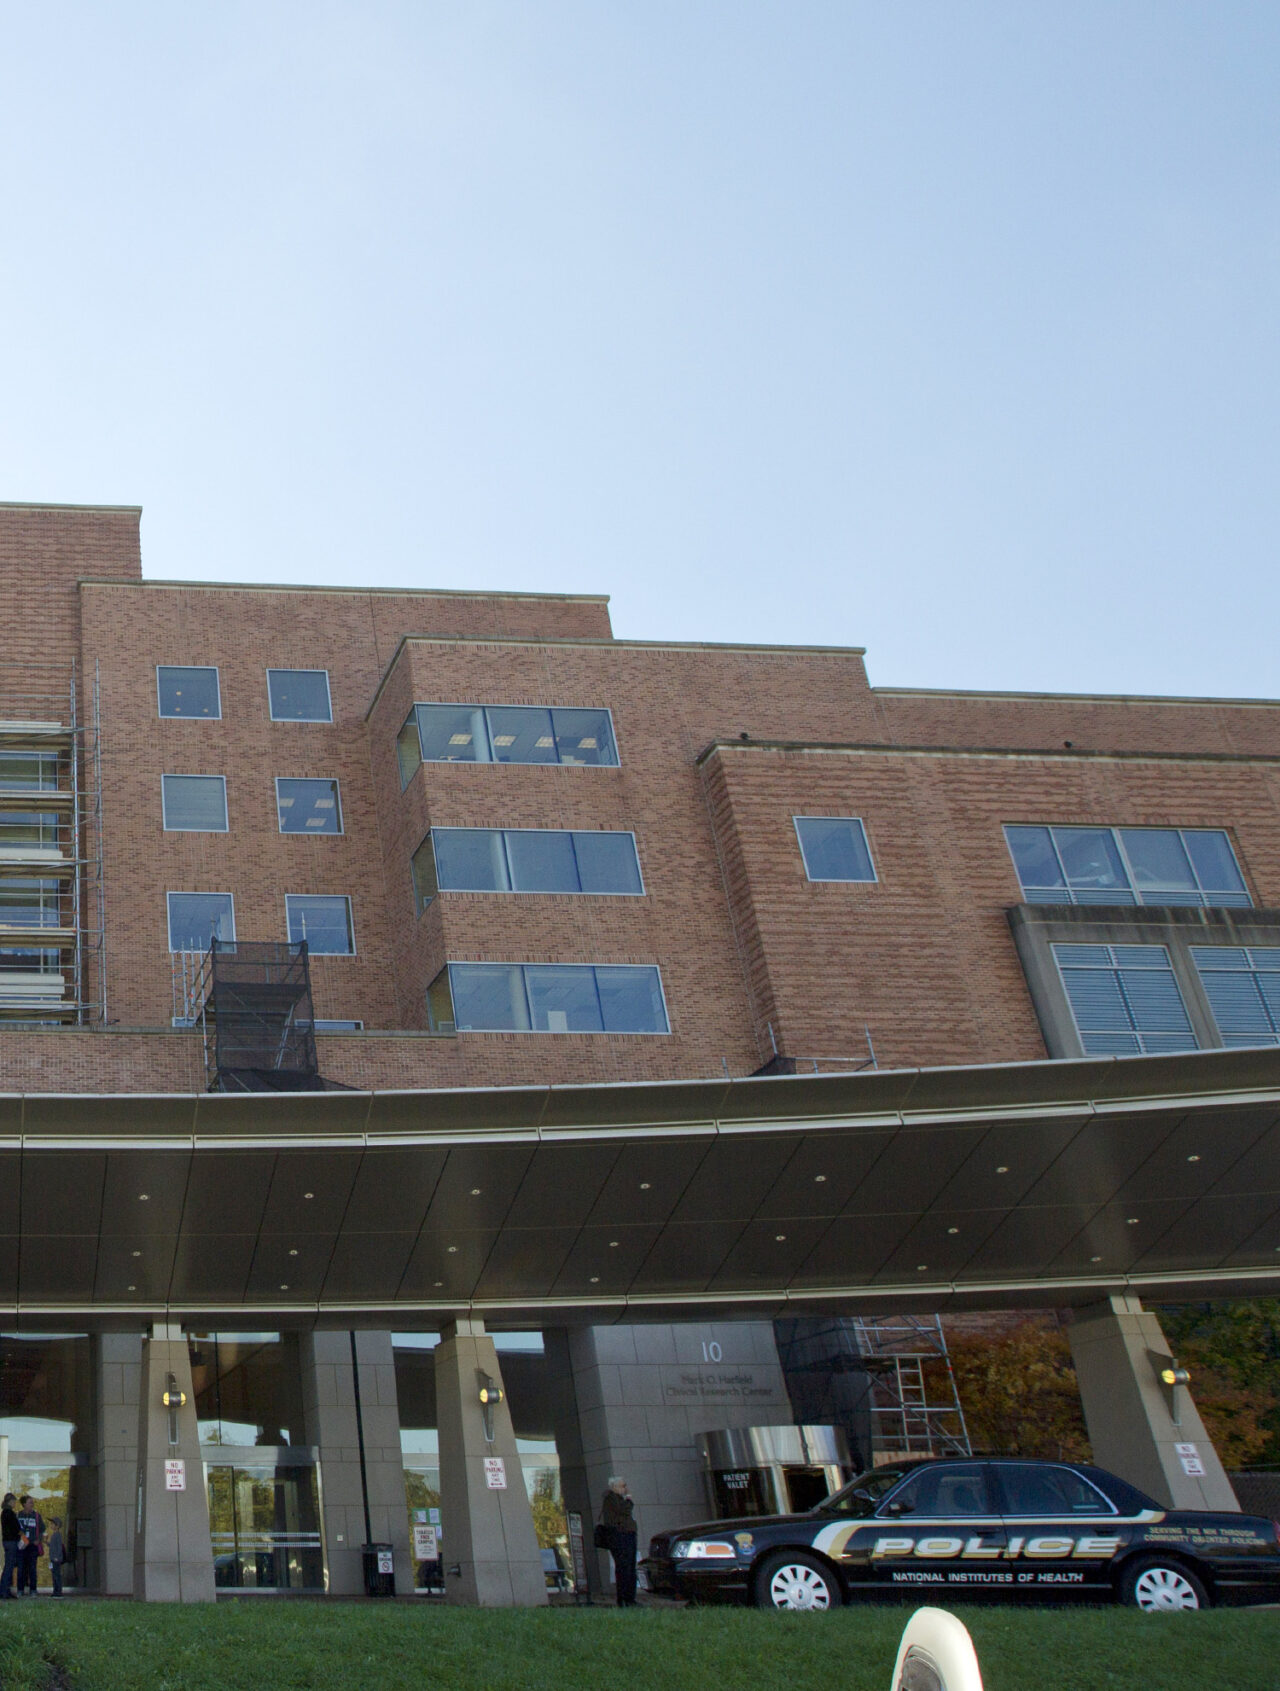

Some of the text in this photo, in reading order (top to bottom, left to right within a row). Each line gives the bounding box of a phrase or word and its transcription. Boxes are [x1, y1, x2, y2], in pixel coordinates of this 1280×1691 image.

[702, 1341, 722, 1362] 10
[723, 1473, 750, 1481] PATIENT
[726, 1481, 749, 1489] VALET
[1149, 1527, 1183, 1535] SERVING
[1186, 1527, 1202, 1535] THE
[1219, 1528, 1256, 1537] THROUGH
[1143, 1534, 1190, 1542] COMMUNITY
[1231, 1536, 1266, 1545] POLICING
[872, 1537, 1125, 1559] POLICE
[892, 1573, 1084, 1584] NATIONAL INSTITUTES OF HEALTH
